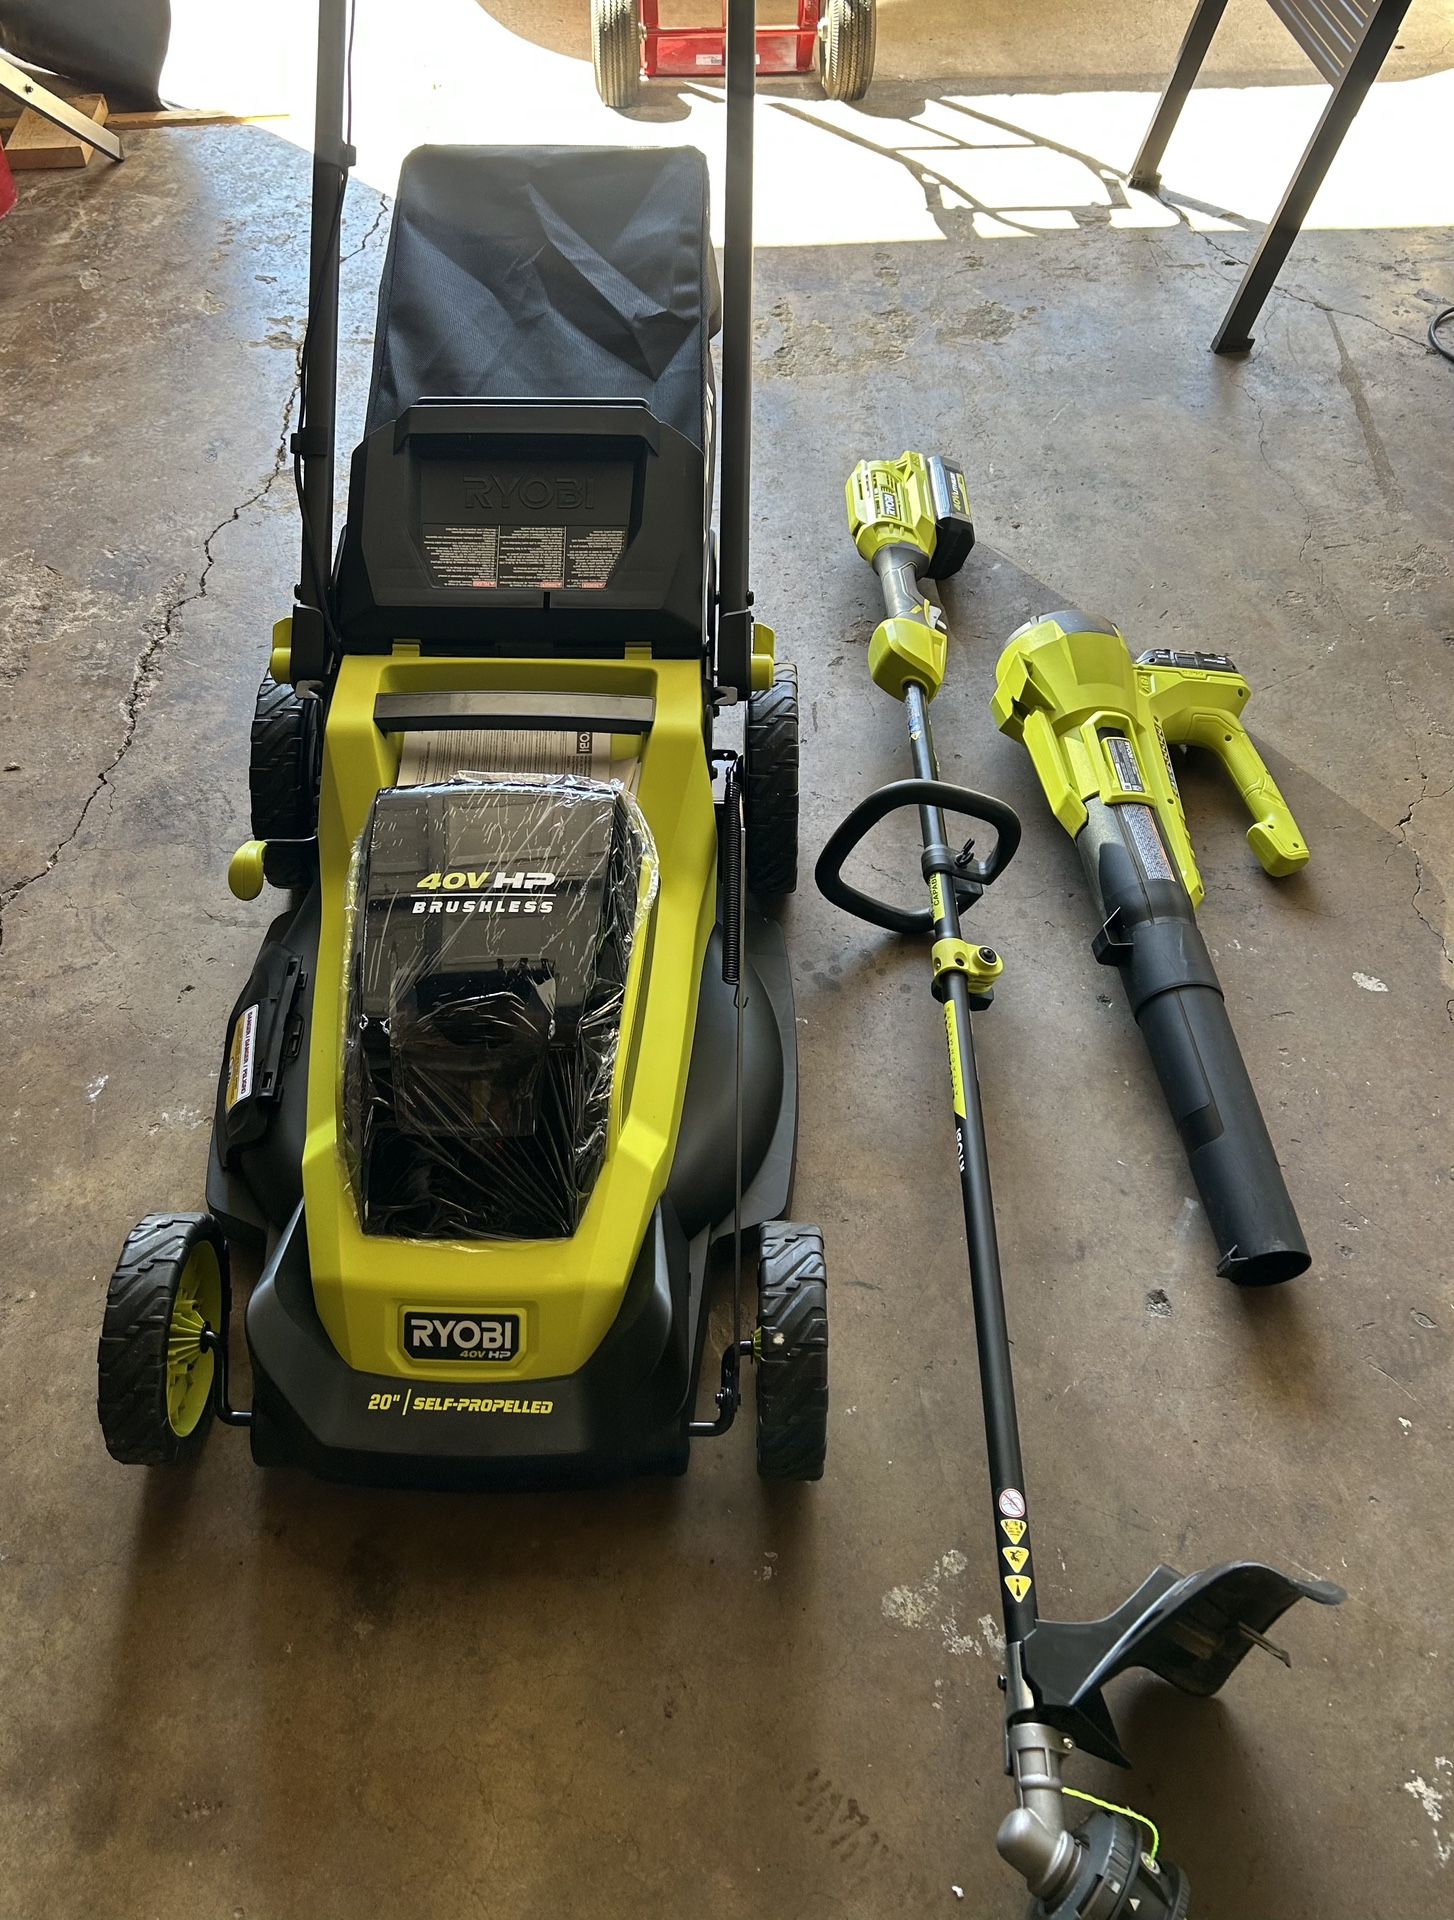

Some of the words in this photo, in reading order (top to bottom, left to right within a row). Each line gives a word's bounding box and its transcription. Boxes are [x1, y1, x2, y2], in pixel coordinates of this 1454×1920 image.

[462, 473, 596, 510] RYOBI
[884, 493, 896, 516] RYOBI
[579, 731, 590, 752] OBI
[417, 872, 490, 889] 40V
[492, 872, 556, 889] HP
[931, 873, 940, 907] CAPABL
[412, 900, 554, 914] BRUSHLESS
[411, 1319, 512, 1349] RYOBI
[459, 1350, 485, 1359] 40V
[488, 1350, 511, 1359] HP
[368, 1394, 400, 1410] 20"
[413, 1397, 553, 1414] SELF-PROPELLED
